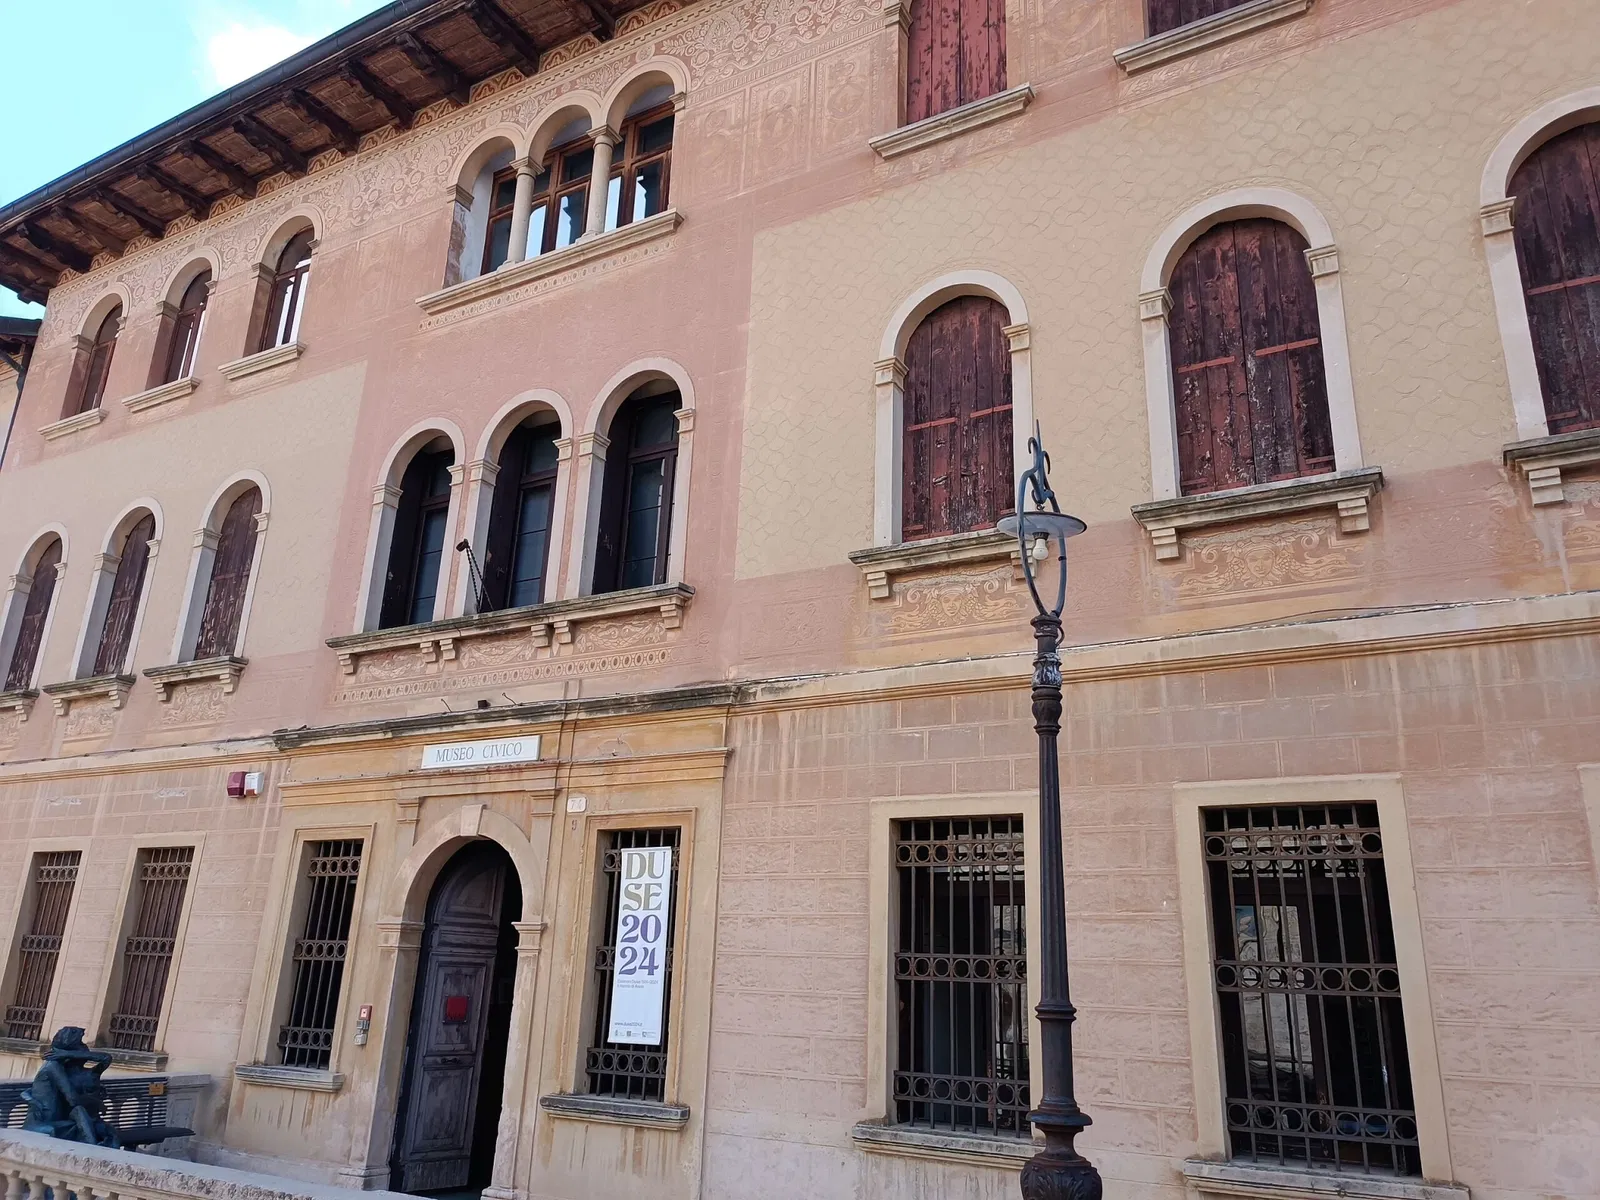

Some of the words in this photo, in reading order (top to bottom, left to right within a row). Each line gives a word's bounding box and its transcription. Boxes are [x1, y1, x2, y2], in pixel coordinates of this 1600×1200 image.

[435, 746, 474, 762] MUSEO
[482, 742, 522, 759] CIVICO
[625, 851, 666, 880] DU
[622, 883, 662, 911] SE
[620, 914, 661, 943] 20
[619, 946, 659, 976] 24
